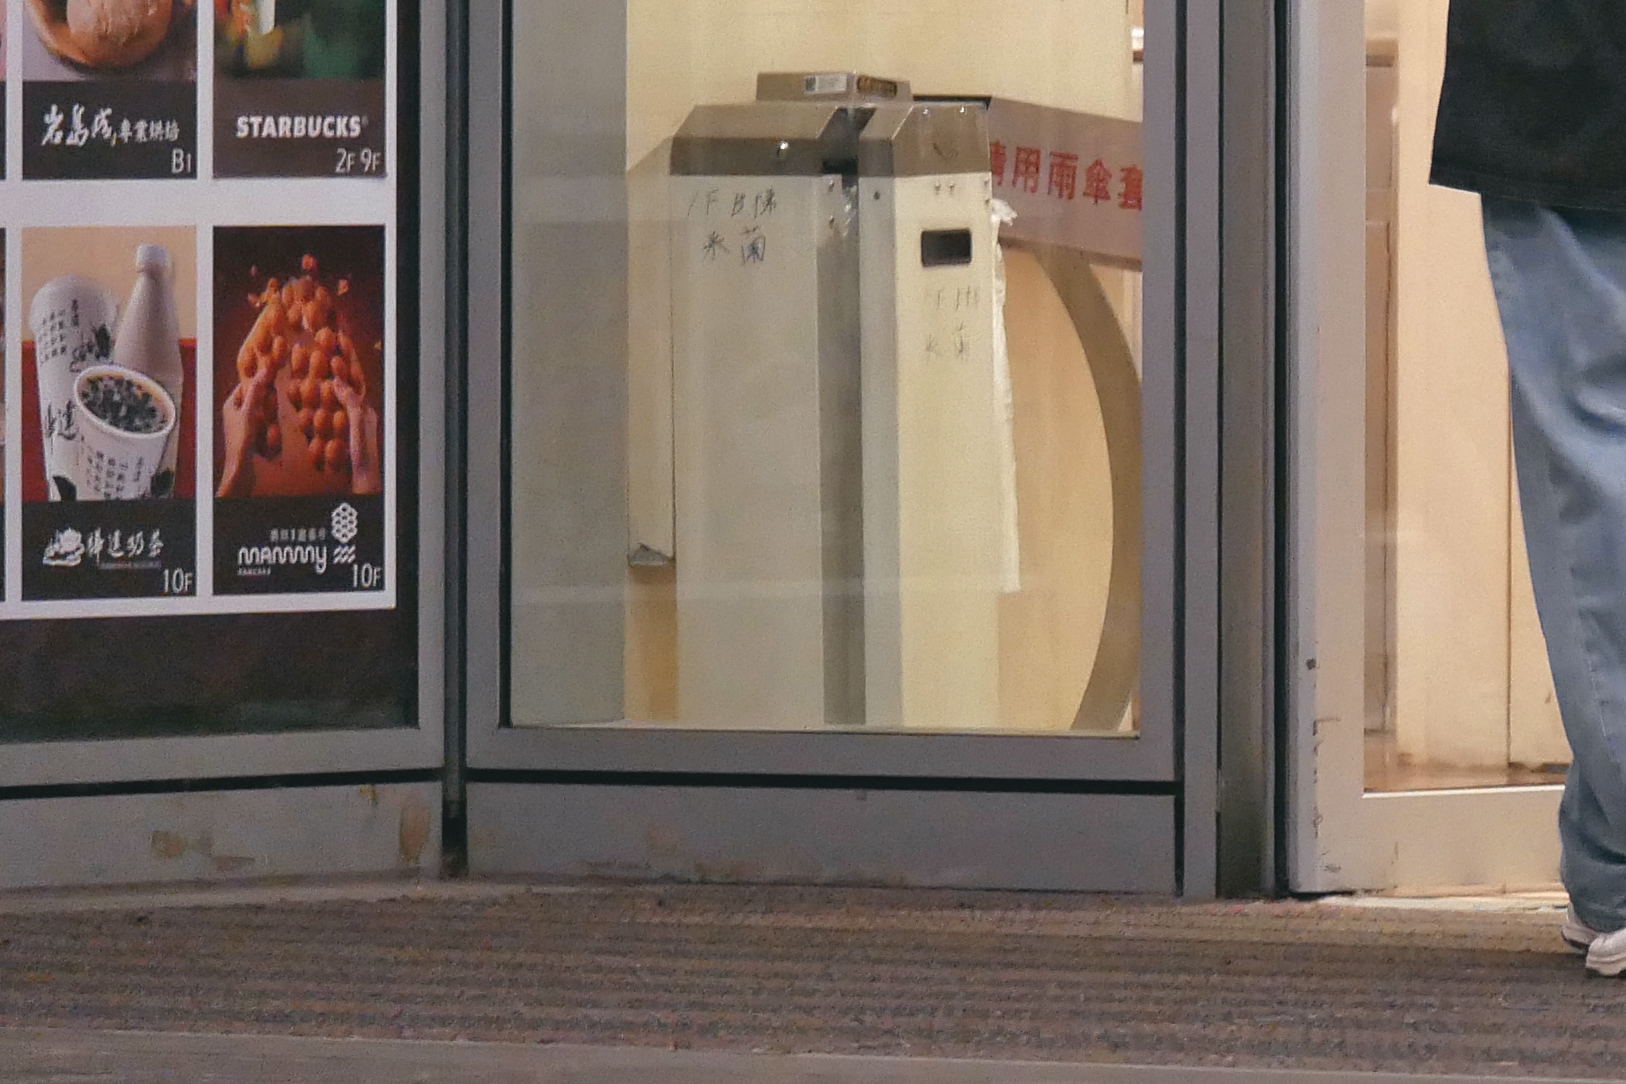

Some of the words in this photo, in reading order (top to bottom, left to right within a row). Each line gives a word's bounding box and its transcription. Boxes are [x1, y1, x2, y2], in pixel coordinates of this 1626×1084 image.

[235, 115, 362, 138] STARBUCKS
[171, 148, 192, 173] B1
[335, 148, 355, 173] 2F
[360, 147, 381, 172] 9F
[162, 568, 194, 595] 10F
[351, 563, 382, 588] 10F
